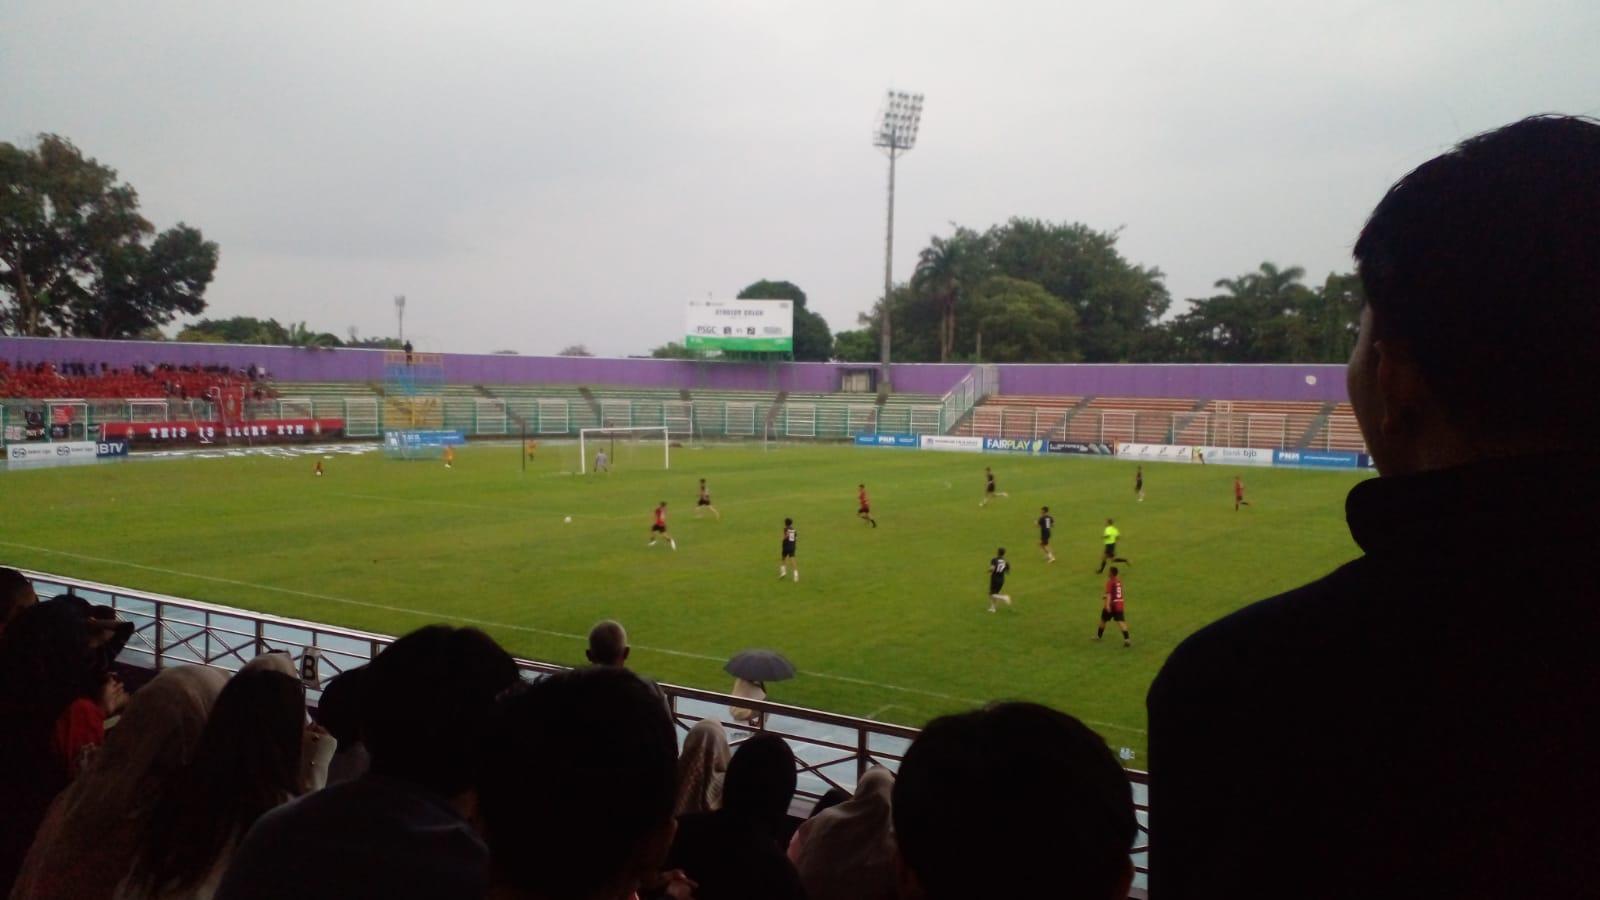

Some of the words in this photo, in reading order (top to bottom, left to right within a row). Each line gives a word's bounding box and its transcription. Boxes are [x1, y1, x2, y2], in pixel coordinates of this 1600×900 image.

[697, 326, 717, 335] PSGC
[150, 427, 188, 439] THIS
[199, 426, 215, 438] IS
[987, 440, 1031, 450] FAIRPLAY
[1243, 449, 1257, 459] bjb
[1278, 451, 1300, 461] PNM
[302, 654, 316, 680] B
